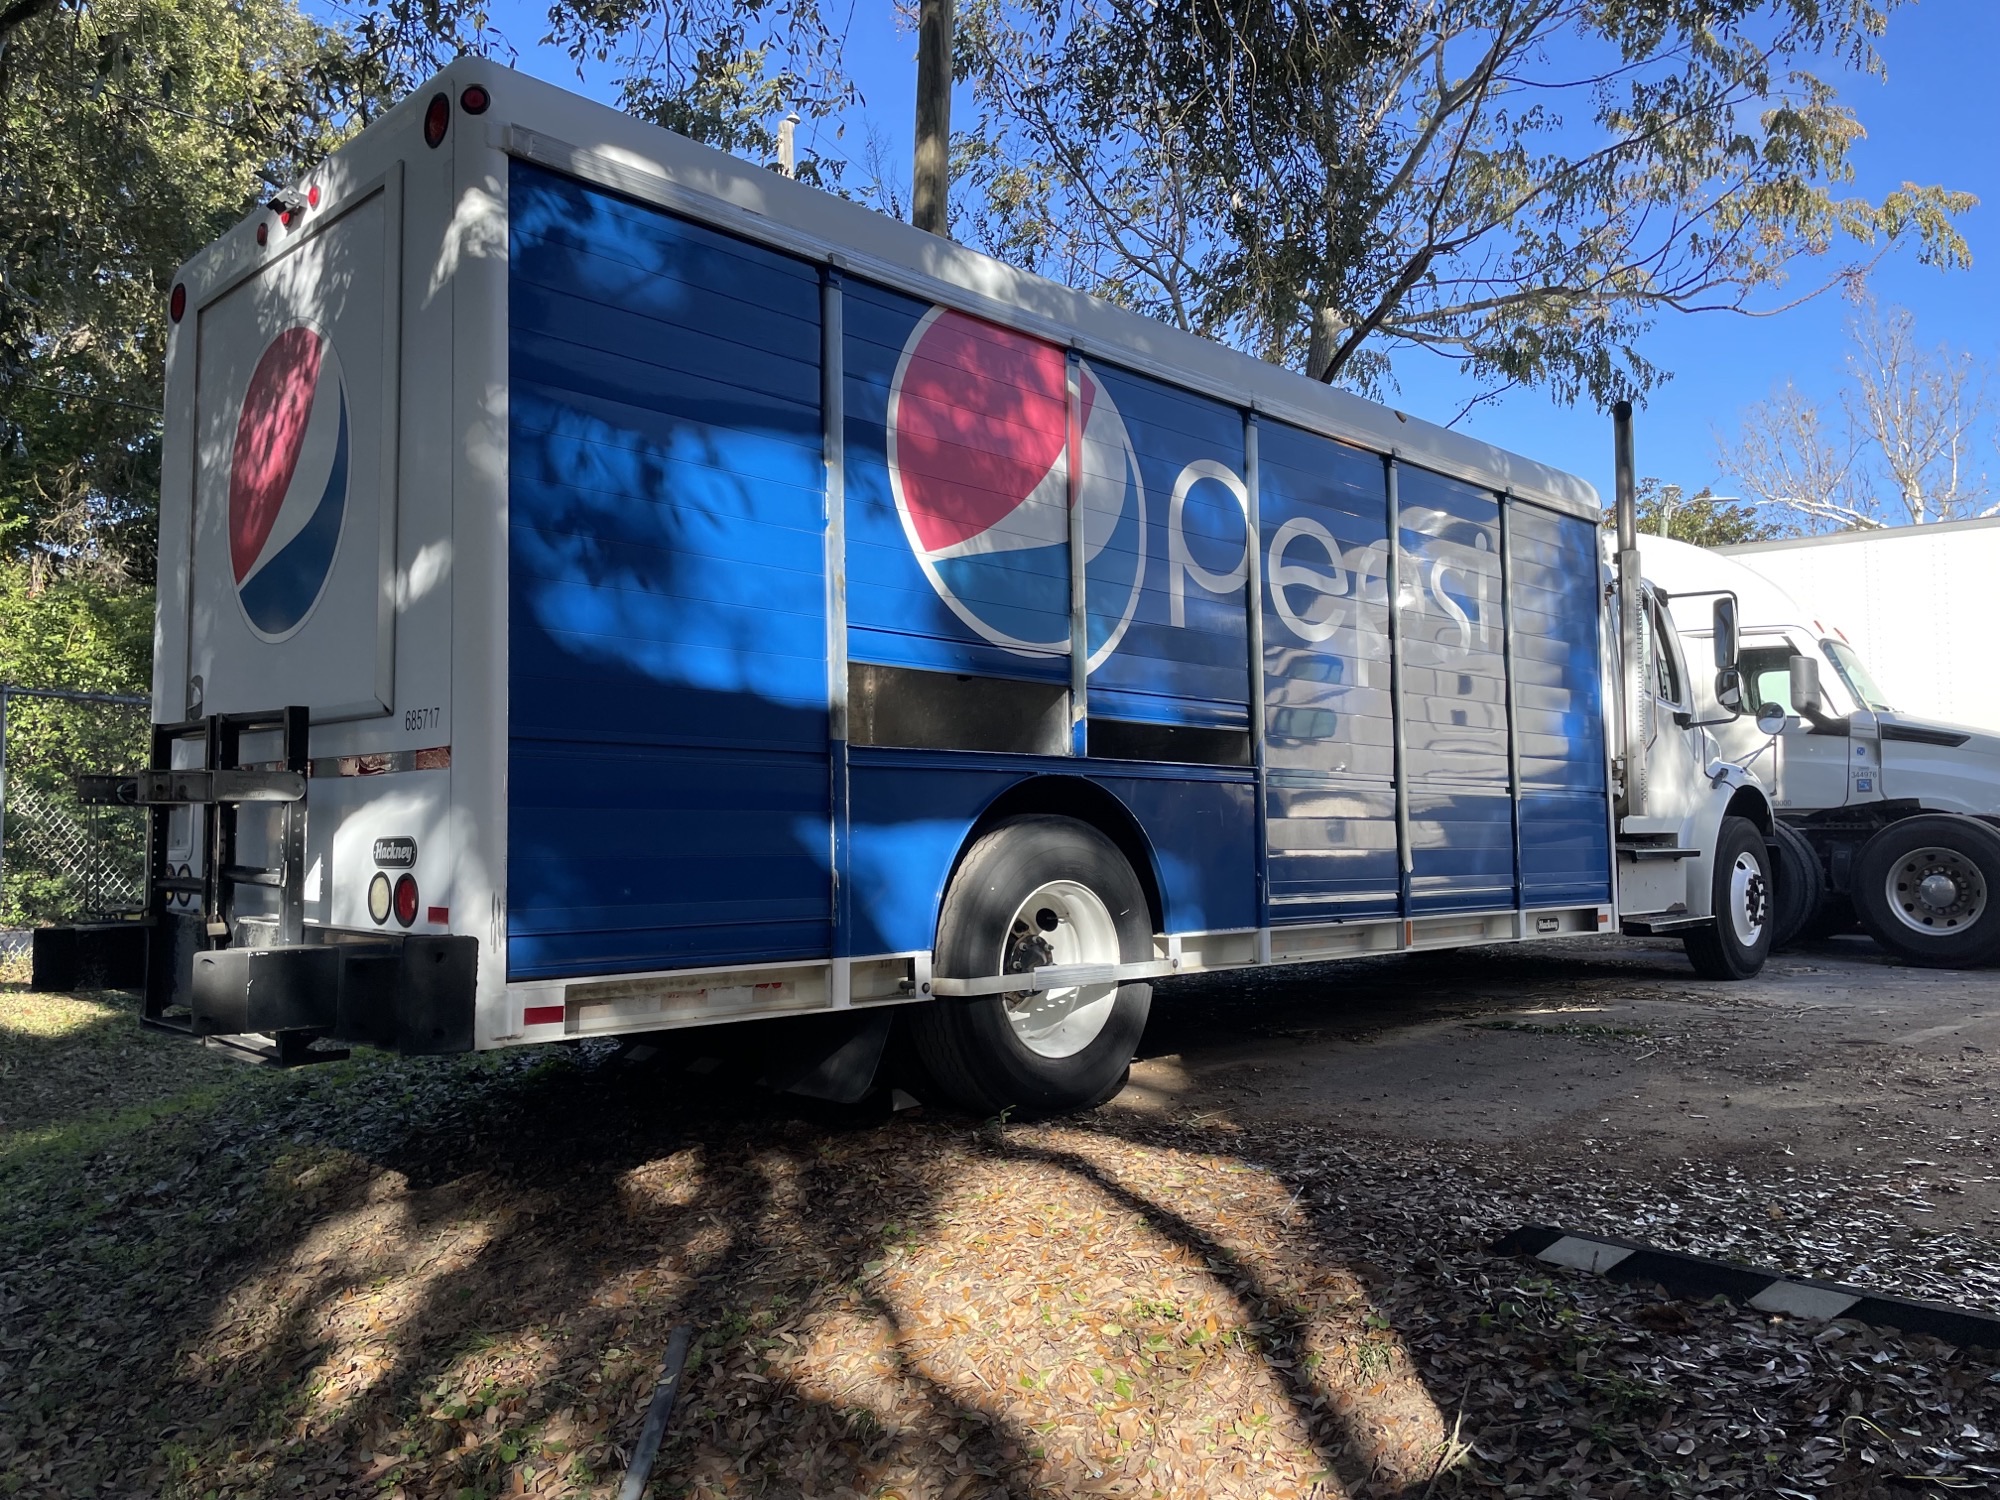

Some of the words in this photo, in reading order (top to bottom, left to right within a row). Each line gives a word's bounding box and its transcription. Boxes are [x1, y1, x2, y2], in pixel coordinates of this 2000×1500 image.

[1168, 459, 1489, 687] pepsi
[405, 707, 440, 731] 685717
[375, 841, 413, 863] Hackney
